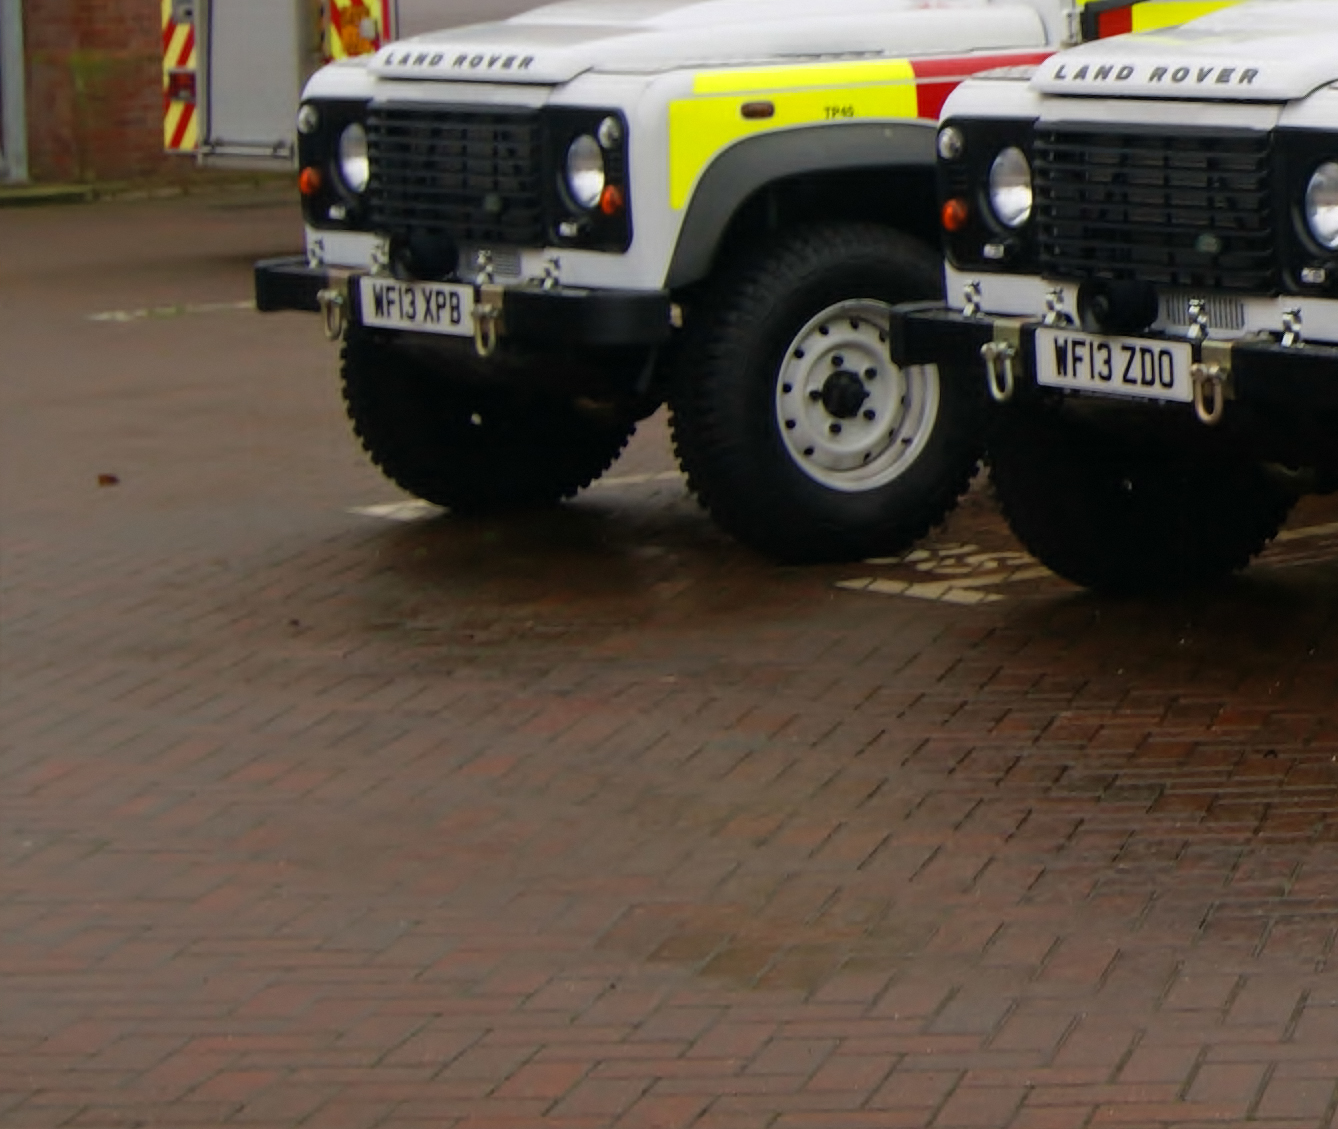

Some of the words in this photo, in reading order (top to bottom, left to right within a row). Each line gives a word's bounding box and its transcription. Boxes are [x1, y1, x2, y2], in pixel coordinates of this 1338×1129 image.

[384, 52, 444, 66] LAND
[452, 54, 534, 70] ROVER
[1053, 64, 1135, 81] LAND
[1148, 67, 1260, 84] ROVER
[373, 283, 417, 320] WF13
[422, 288, 461, 324] XPB
[1054, 336, 1112, 381] WF13
[1120, 343, 1174, 389] ZDO
